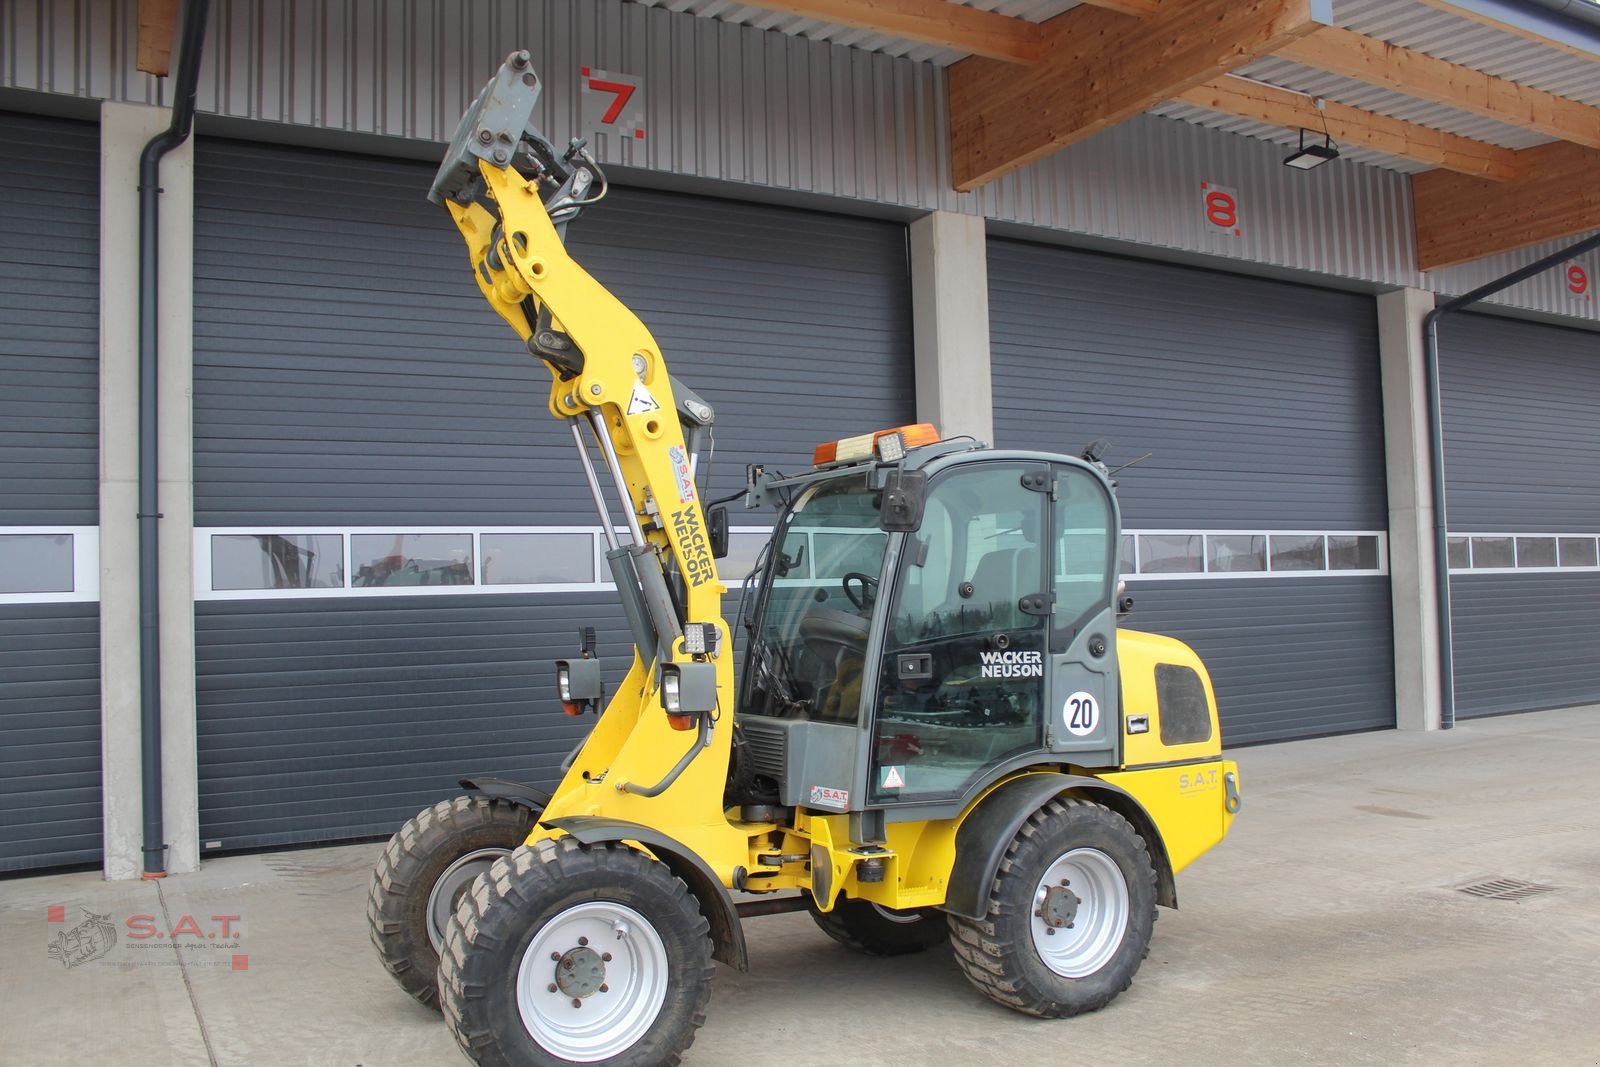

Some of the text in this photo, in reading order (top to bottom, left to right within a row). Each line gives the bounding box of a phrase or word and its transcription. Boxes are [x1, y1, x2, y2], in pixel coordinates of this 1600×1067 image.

[588, 79, 637, 124] 7
[1206, 191, 1237, 228] 8
[1568, 265, 1587, 294] 9
[671, 510, 703, 588] NEUSON
[684, 505, 714, 584] WACKER
[980, 651, 1042, 664] WACKER
[981, 664, 1043, 678] NEUSON
[1070, 698, 1093, 729] 20
[1178, 769, 1218, 789] S.A.T.
[823, 789, 848, 801] S.A.T.
